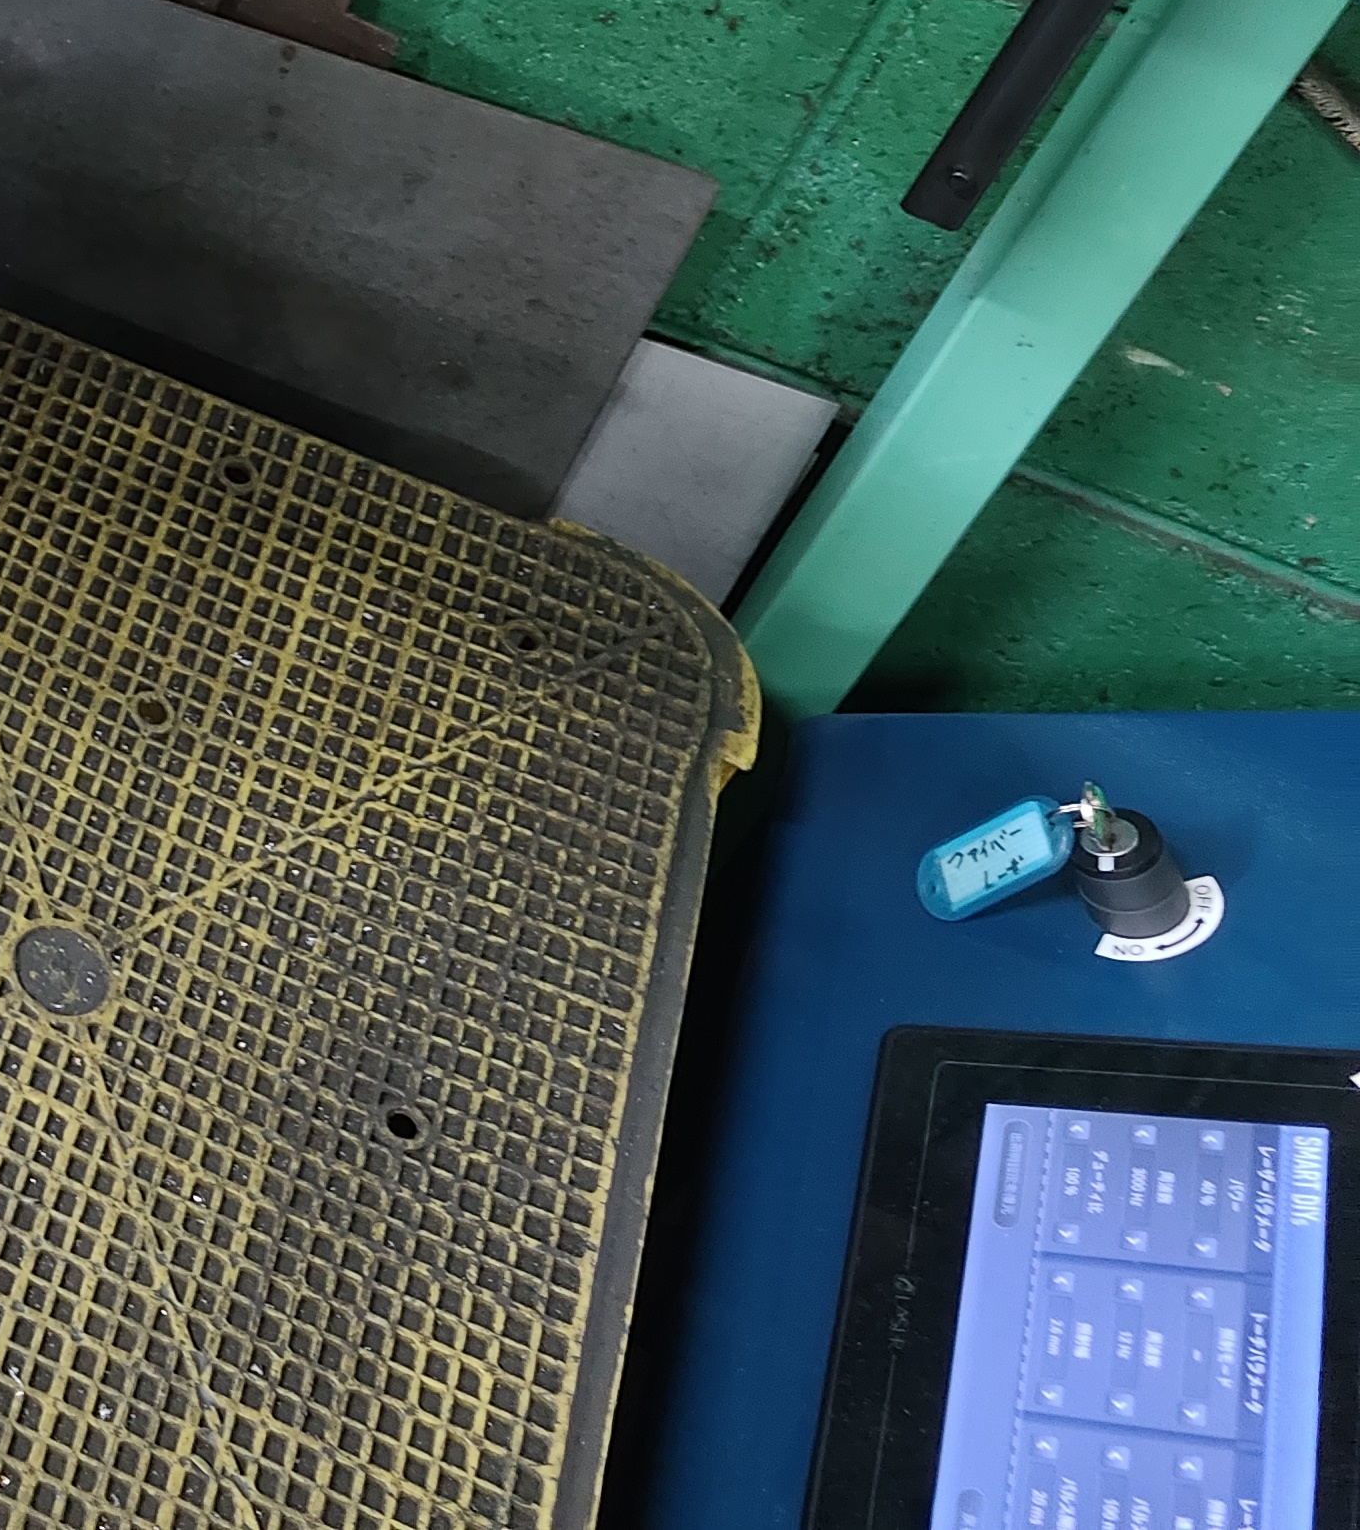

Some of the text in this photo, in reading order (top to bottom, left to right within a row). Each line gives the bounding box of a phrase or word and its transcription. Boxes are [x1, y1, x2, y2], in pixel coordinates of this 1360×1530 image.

[1194, 884, 1212, 913] OFF
[1112, 943, 1146, 956] ON
[1292, 1135, 1324, 1190] SMART
